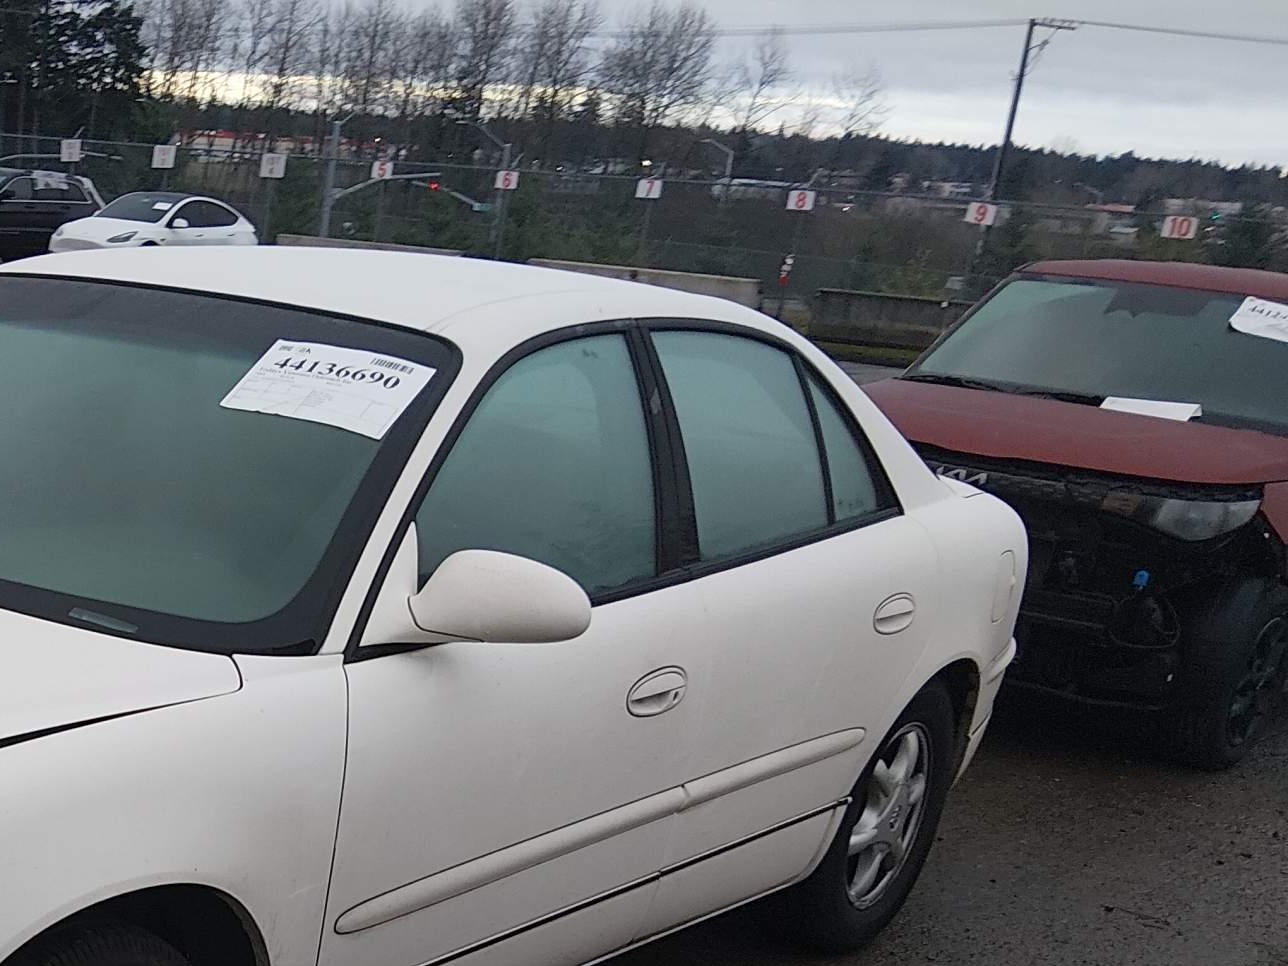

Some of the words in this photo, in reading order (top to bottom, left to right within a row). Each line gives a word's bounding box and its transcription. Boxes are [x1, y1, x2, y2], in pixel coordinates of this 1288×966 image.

[376, 160, 387, 178] 5
[502, 171, 512, 188] 6
[645, 180, 656, 198] 7
[795, 191, 808, 209] 8
[973, 205, 988, 223] 9
[1167, 216, 1193, 237] 10
[274, 356, 400, 390] 44136690
